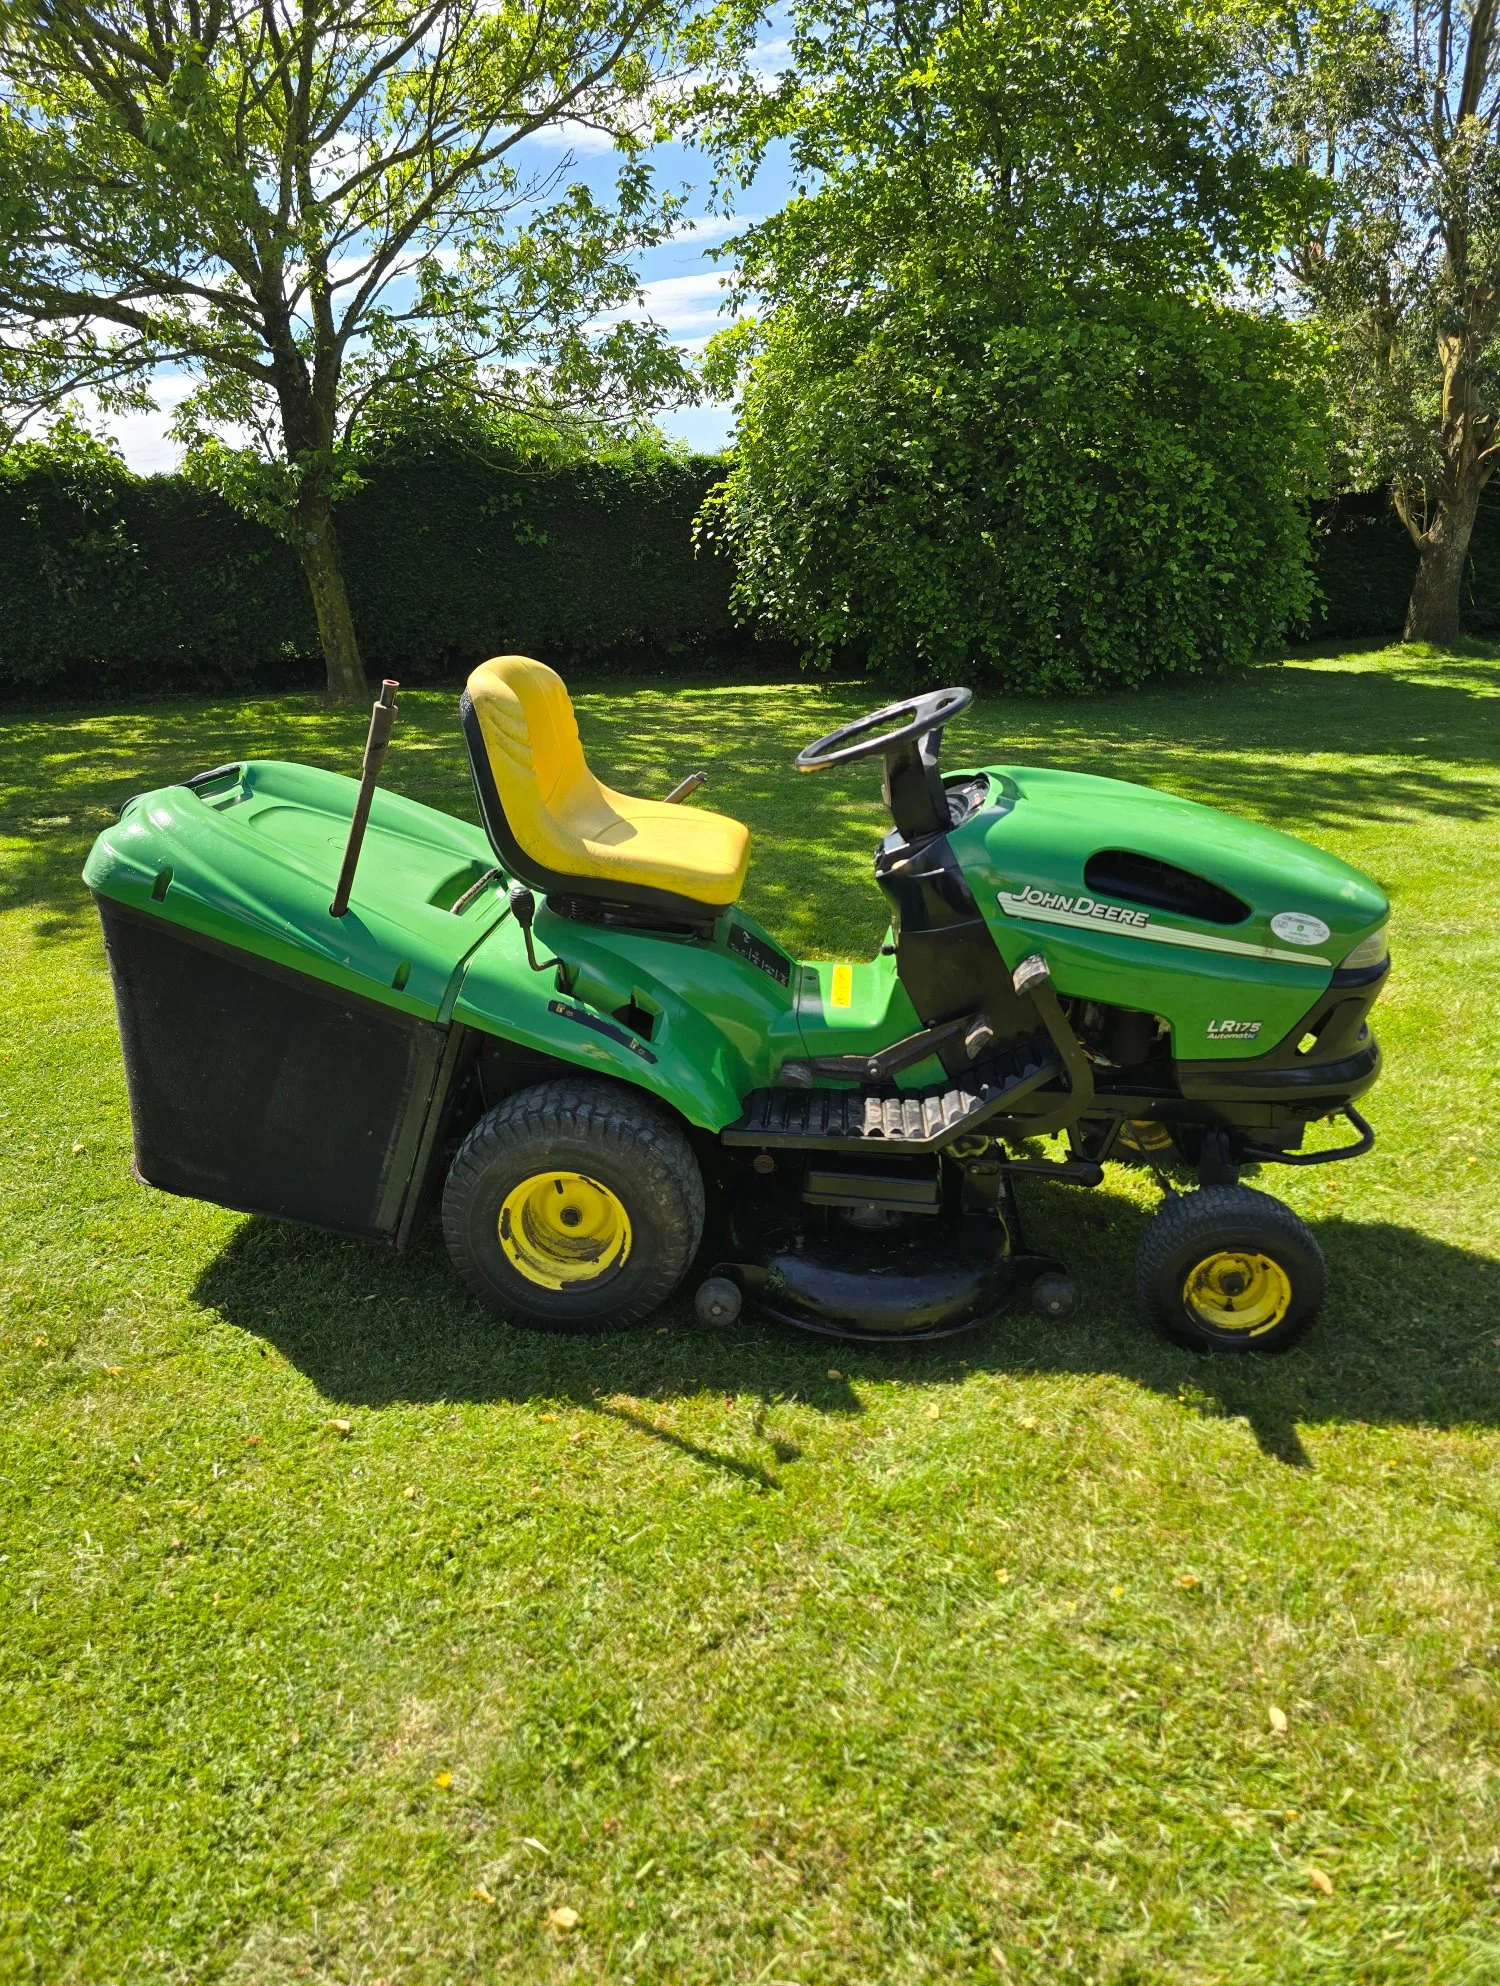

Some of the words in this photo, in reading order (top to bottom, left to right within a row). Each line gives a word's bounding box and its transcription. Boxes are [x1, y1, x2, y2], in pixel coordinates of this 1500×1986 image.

[1011, 885, 1074, 911] JOHN
[1072, 896, 1149, 926] DEERE
[1207, 1020, 1262, 1032] LR175
[1207, 1032, 1256, 1040] Automatic
